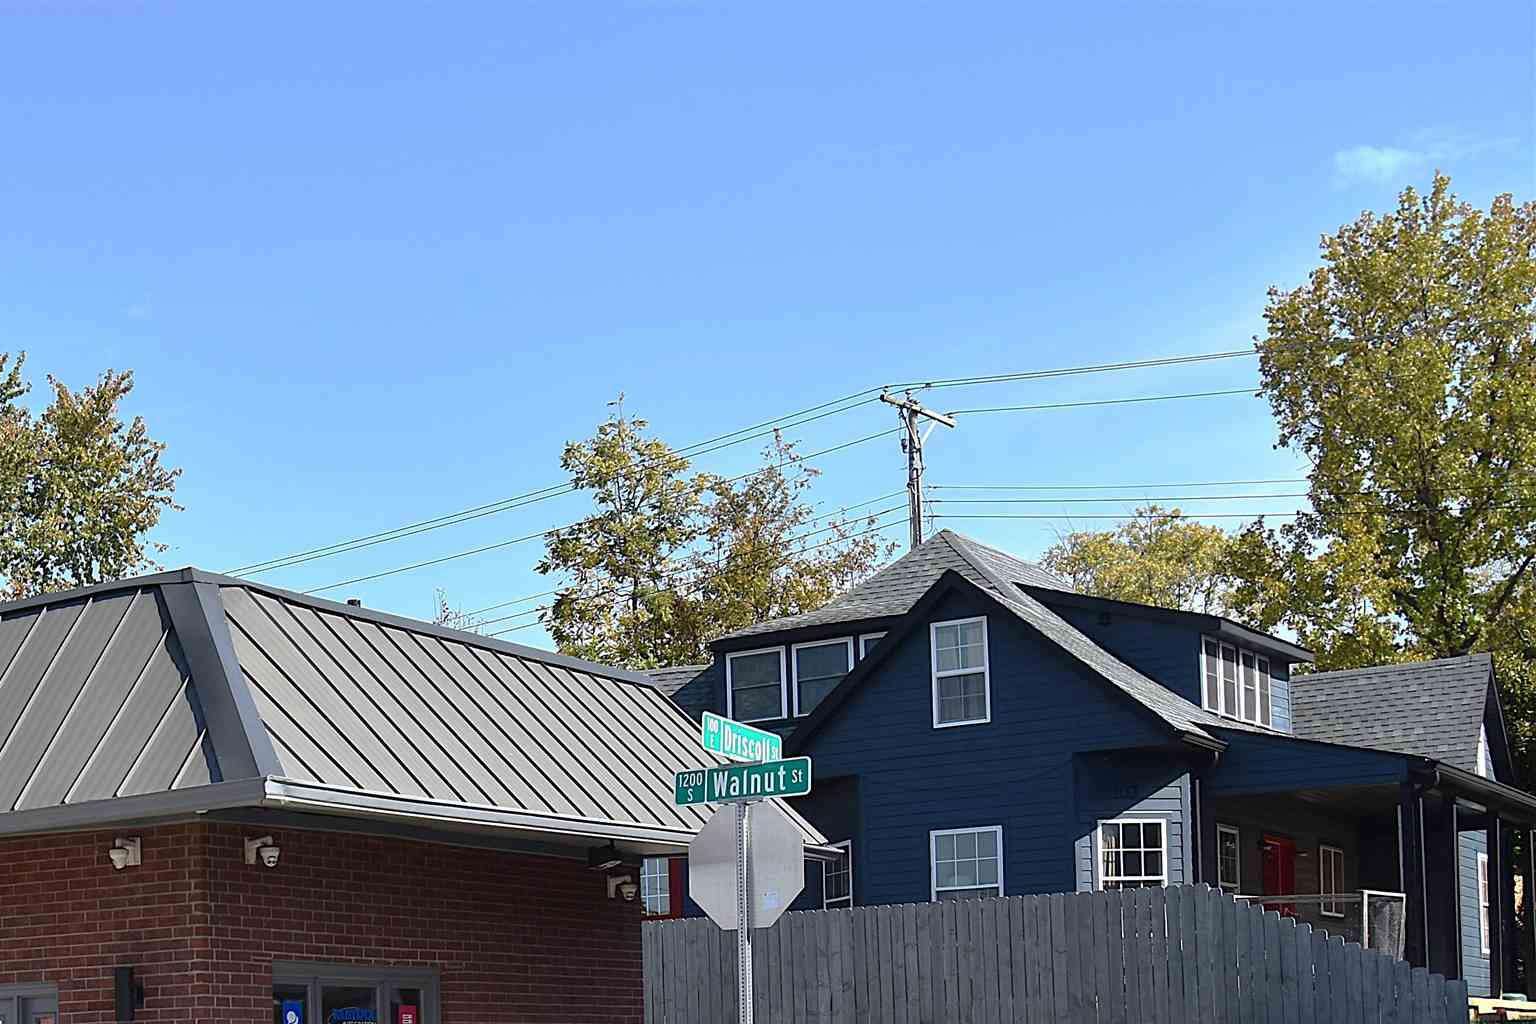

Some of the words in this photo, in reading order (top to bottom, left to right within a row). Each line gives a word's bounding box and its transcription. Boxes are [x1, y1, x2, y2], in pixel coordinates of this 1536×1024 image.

[710, 733, 716, 748] E
[724, 725, 770, 762] Driscoll
[771, 746, 780, 760] St
[679, 773, 703, 787] 1200
[713, 765, 786, 798] Walnut
[791, 769, 803, 783] St
[687, 788, 694, 802] S
